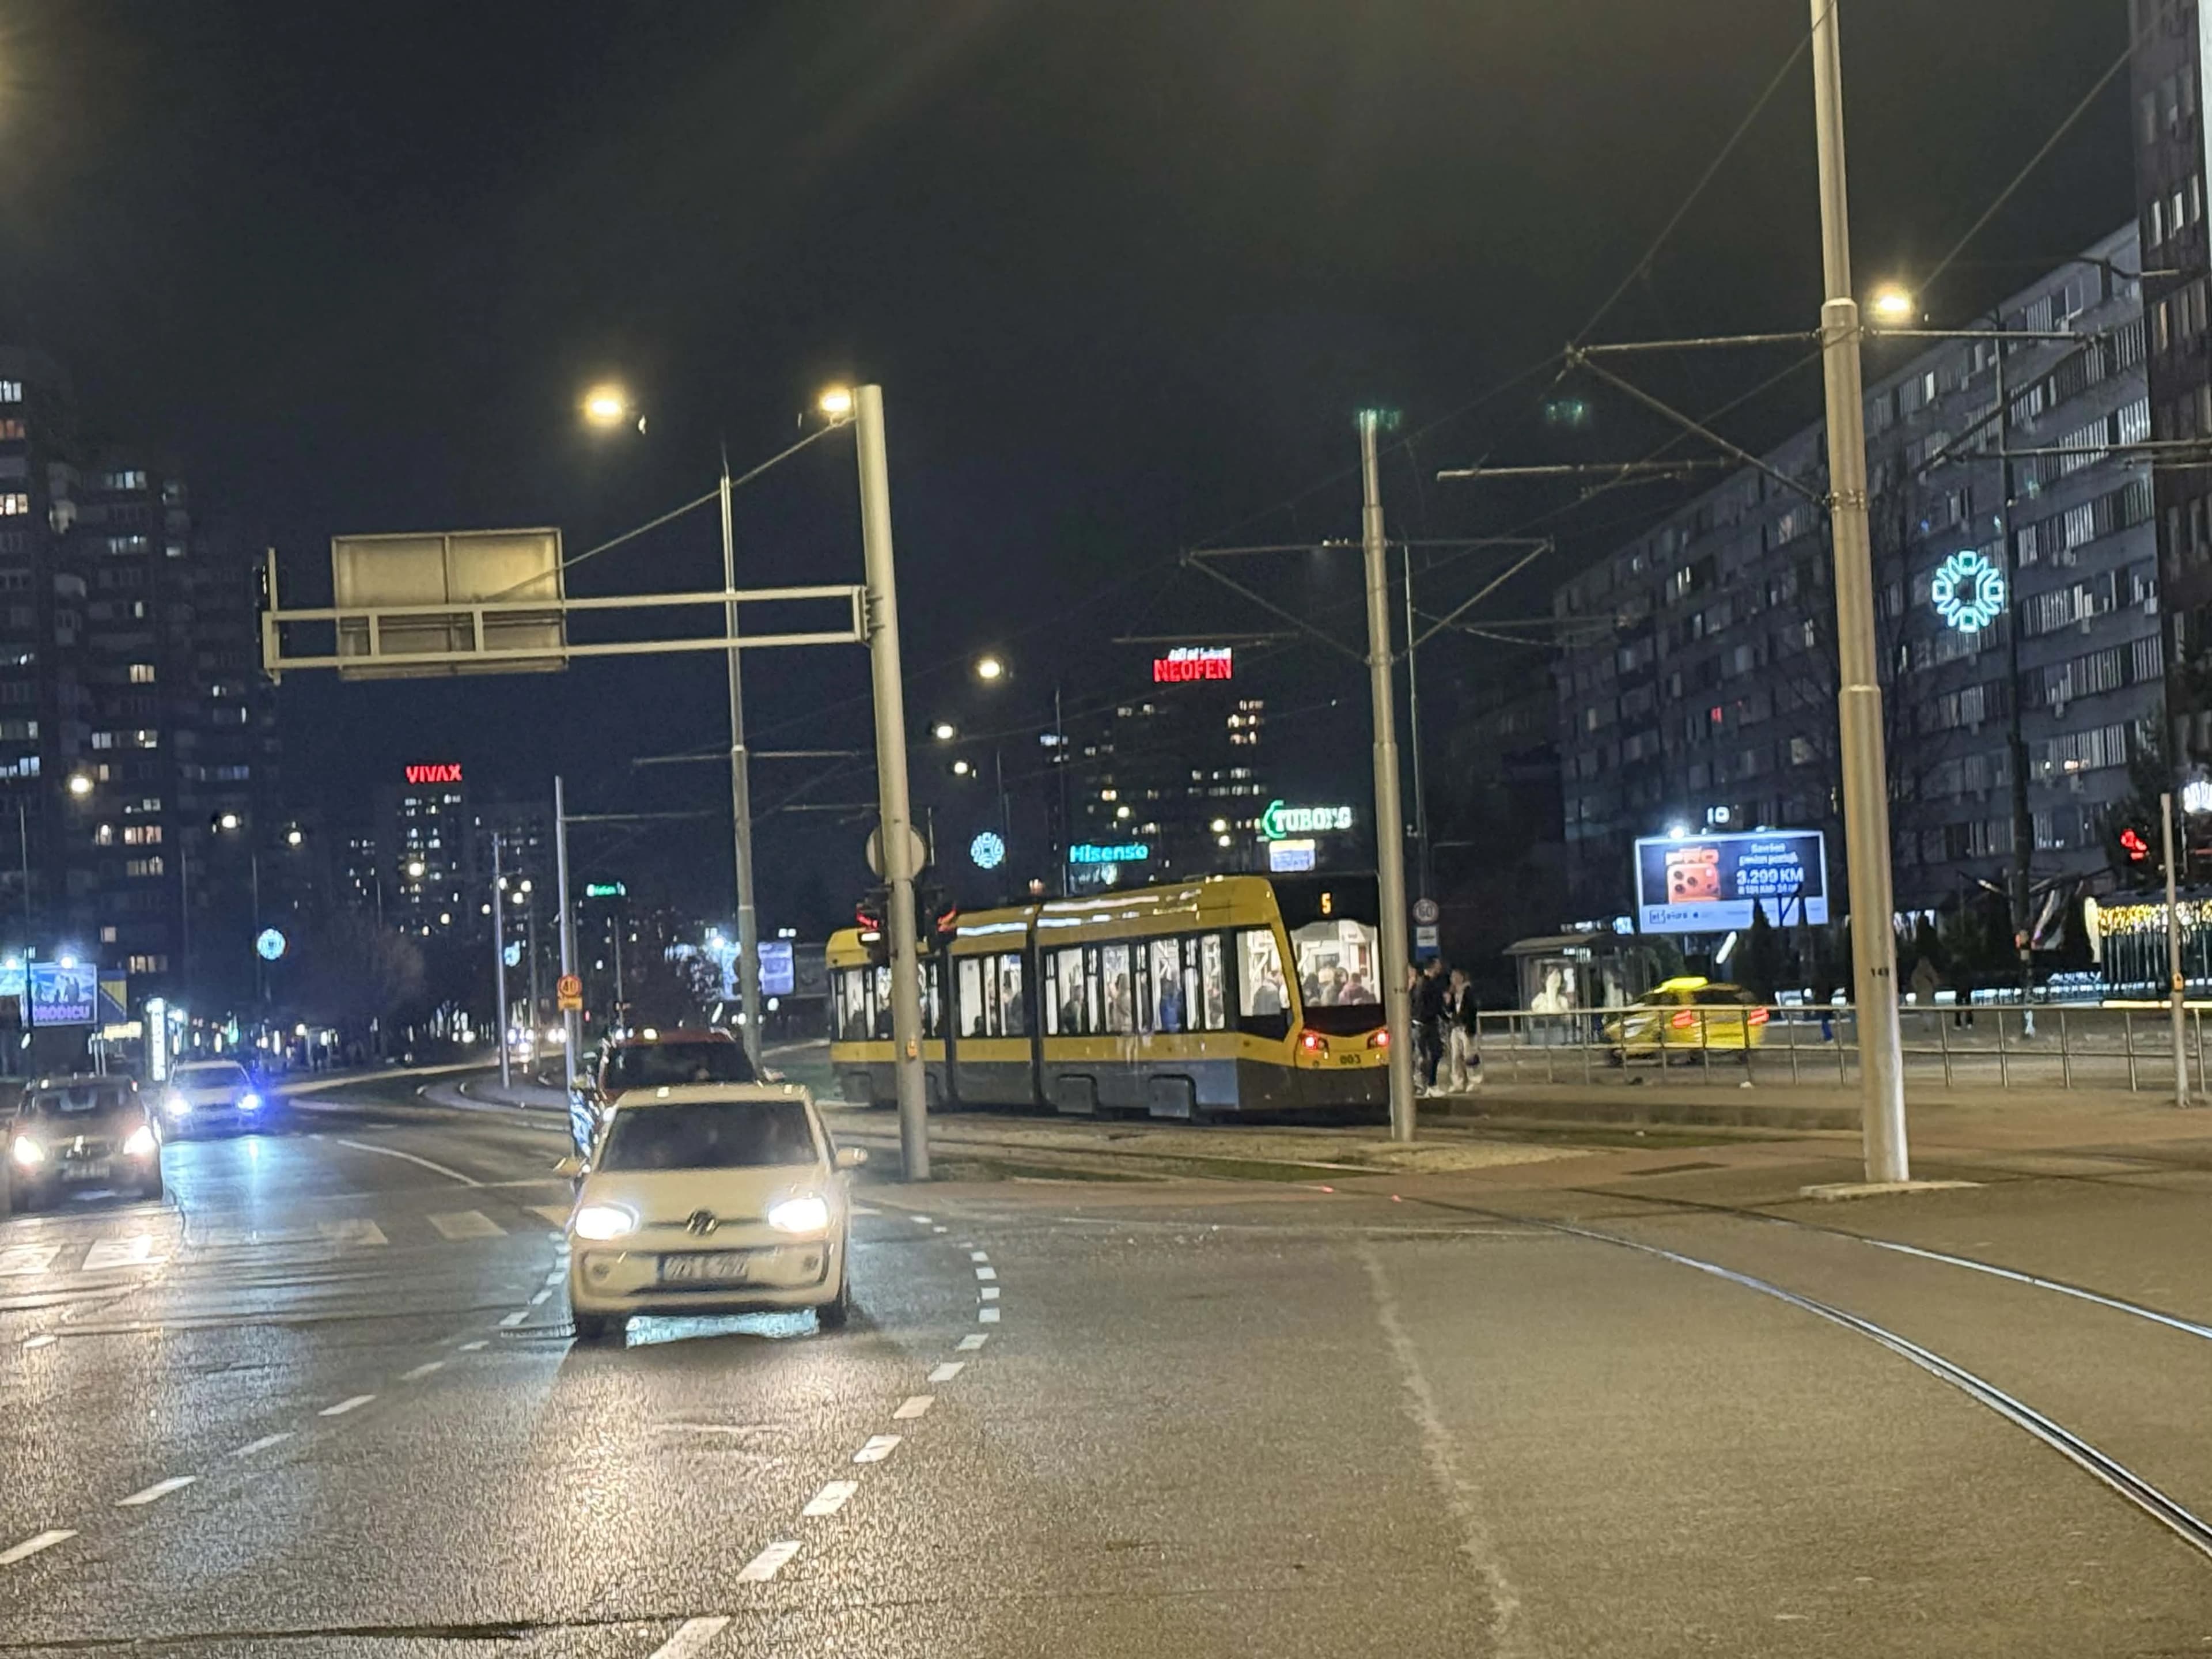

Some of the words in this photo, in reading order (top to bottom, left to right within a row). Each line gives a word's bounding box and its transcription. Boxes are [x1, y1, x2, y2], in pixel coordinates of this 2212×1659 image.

[1154, 660, 1232, 682] NEOFEN
[406, 763, 462, 783] VIVAX
[1779, 867, 1804, 882] KM
[1322, 892, 1331, 914] 5
